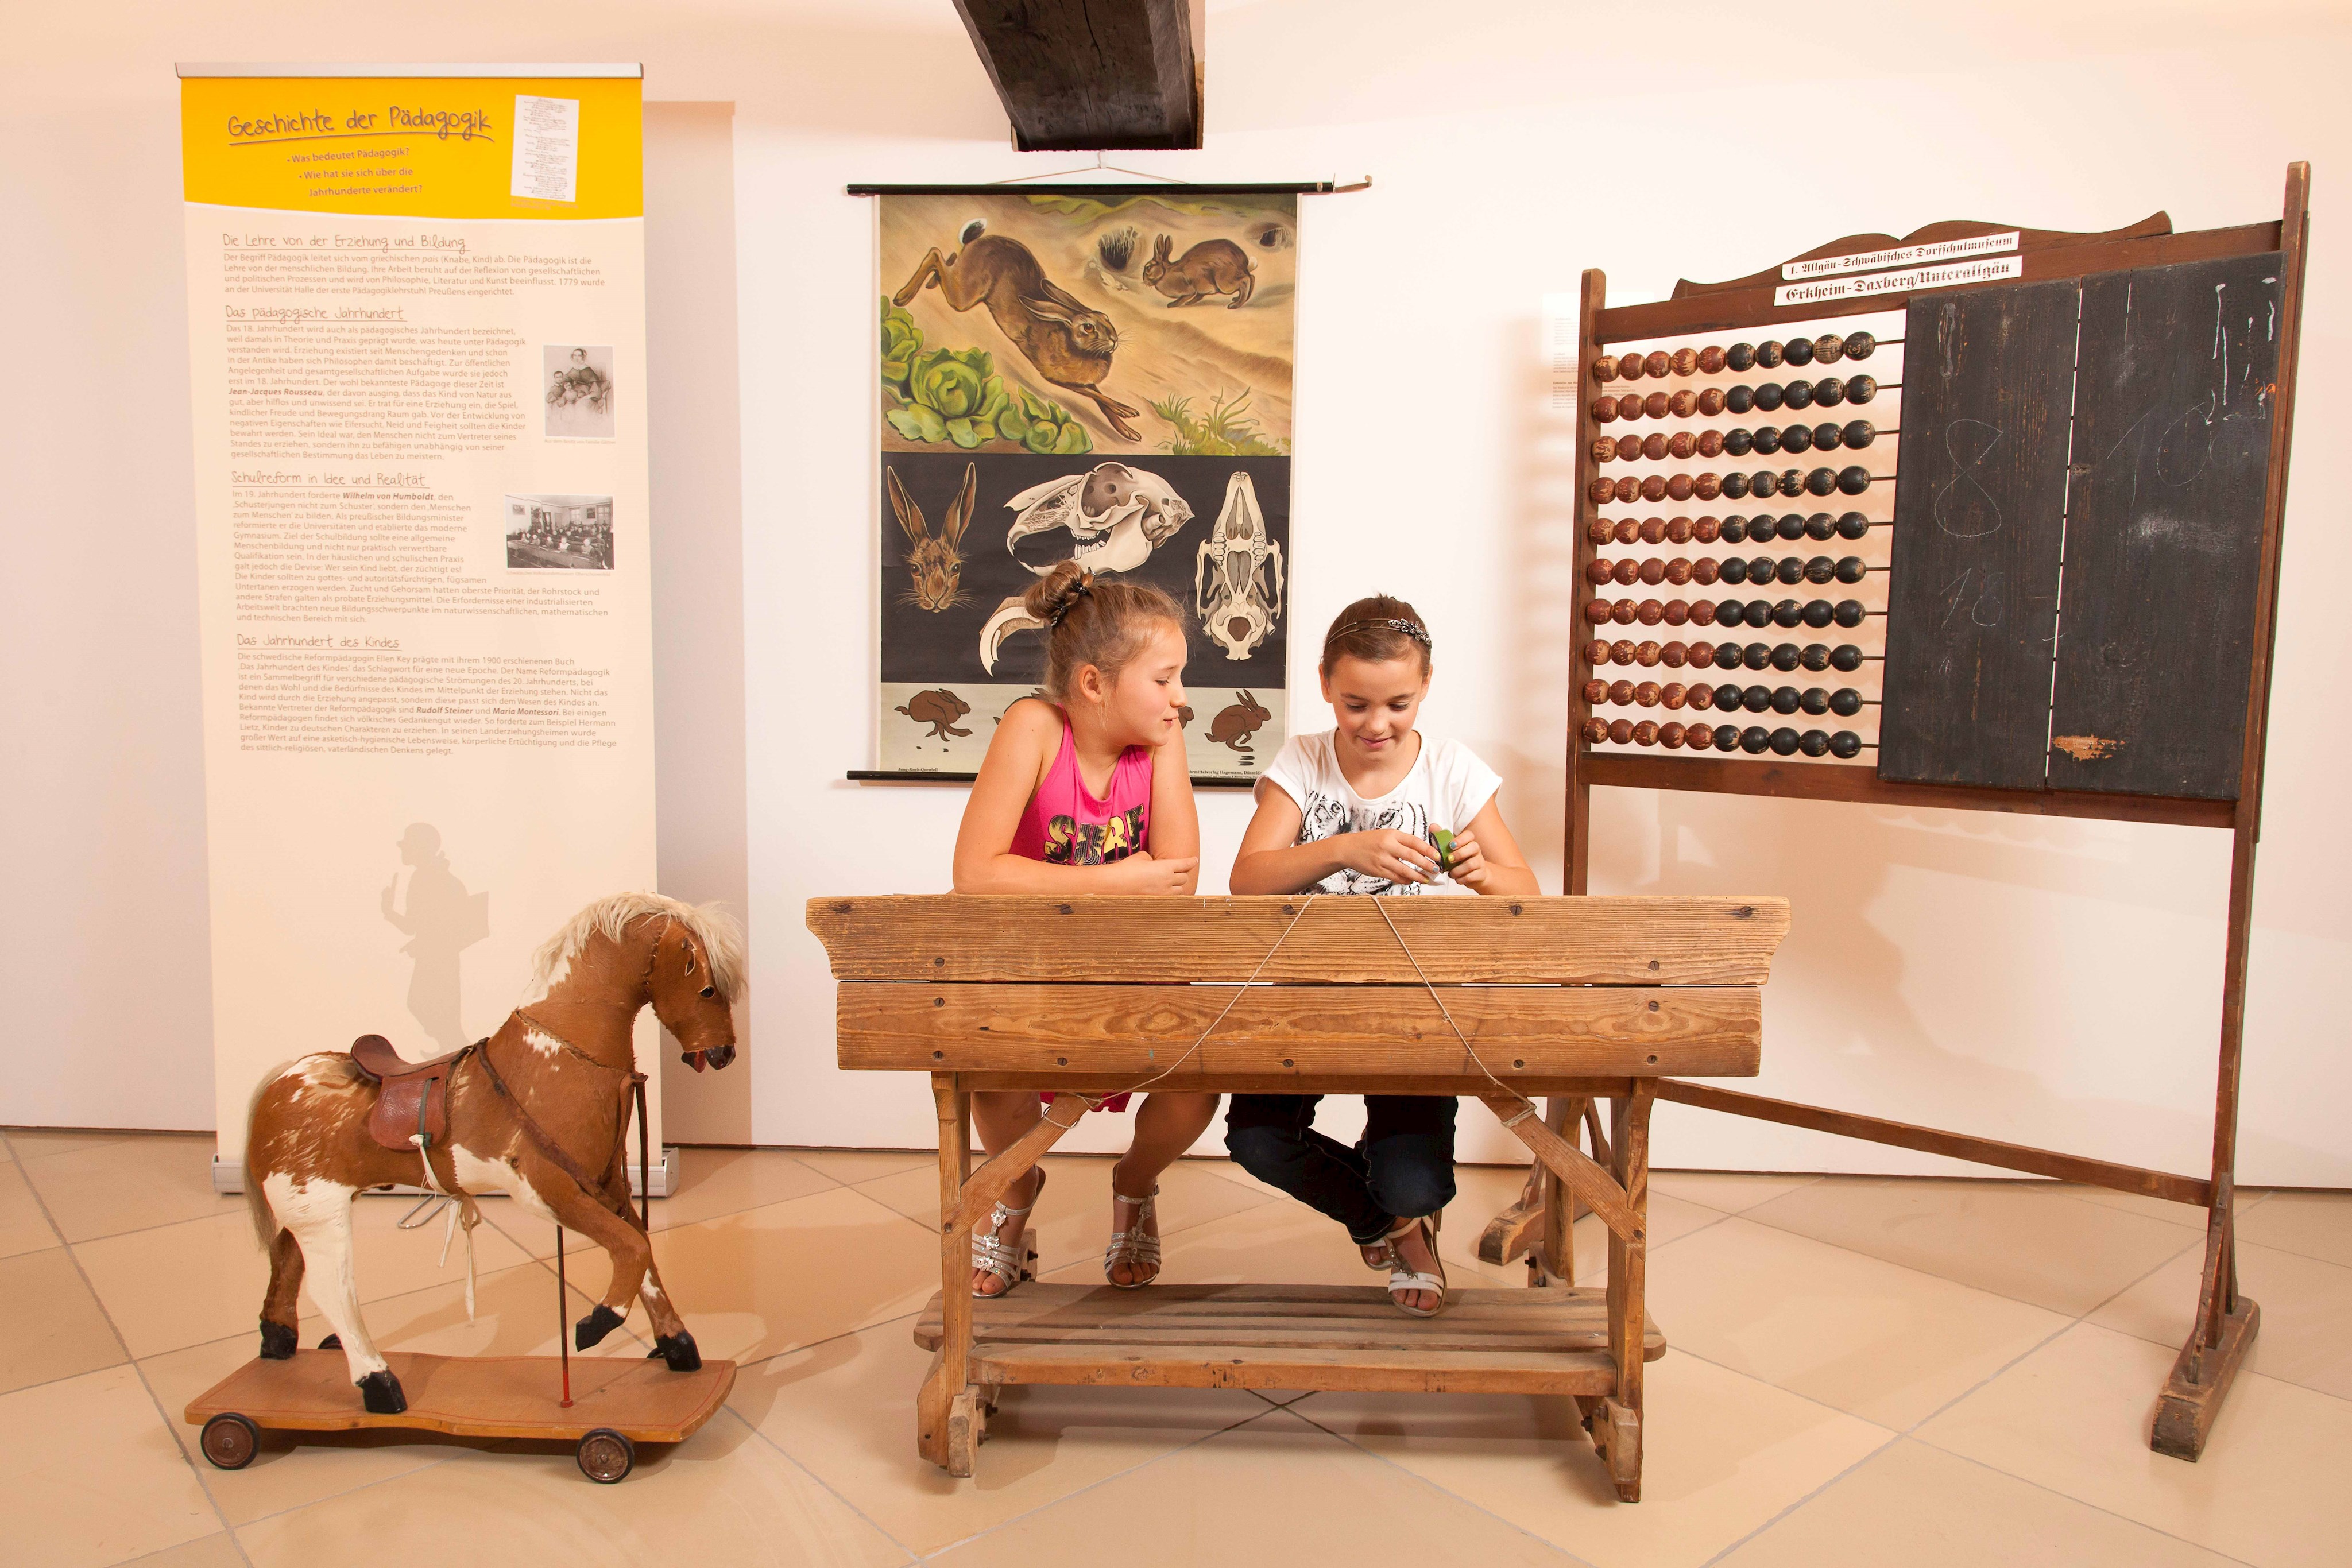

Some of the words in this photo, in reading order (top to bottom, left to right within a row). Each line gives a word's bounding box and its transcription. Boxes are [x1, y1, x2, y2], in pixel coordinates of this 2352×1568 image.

[228, 108, 334, 136] Geschichte
[346, 110, 377, 129] der
[389, 106, 492, 140] Pädagogik
[291, 154, 310, 163] Was
[312, 151, 354, 161] bedeutet
[357, 148, 409, 159] Pädagogik?
[304, 171, 321, 179] Wie
[323, 169, 338, 178] hat
[341, 169, 353, 177] sie
[356, 168, 373, 177] sich
[376, 167, 396, 176] über
[399, 167, 413, 175] die
[308, 186, 371, 197] Jahrhunderte
[373, 185, 422, 195] verändert?
[223, 234, 239, 247] Die
[245, 234, 277, 247] Lehre
[283, 237, 303, 246] von
[310, 236, 328, 247] der
[335, 235, 389, 253] Erziehung
[394, 235, 415, 247] und
[421, 234, 466, 254] Bildung
[223, 253, 238, 261] Der
[240, 253, 266, 263] Begriff
[267, 253, 309, 263] Pädagogik
[311, 254, 331, 262] leitet
[370, 254, 420, 264] griechischen
[422, 255, 438, 264] pais
[473, 255, 492, 264] Kind)
[524, 255, 566, 265] Pädagogik
[579, 257, 591, 266] die
[280, 264, 335, 273] menschlichen
[371, 265, 386, 273] Ihre
[388, 265, 413, 273] Arbeit
[414, 265, 442, 273] beruht
[444, 266, 458, 274] auf
[459, 266, 472, 274] der
[474, 266, 509, 274] Reflexion
[528, 266, 600, 276] gesellschaftlichen
[225, 274, 240, 282] und
[242, 274, 285, 284] politischen
[287, 275, 327, 285] Prozessen
[382, 276, 431, 285] Philosophie,
[433, 276, 467, 285] Literatur
[469, 277, 485, 285] und
[486, 276, 508, 284] Kunst
[510, 277, 556, 285] beeinflusst.
[252, 285, 292, 293] Universität
[295, 285, 314, 293] Halle
[316, 285, 329, 293] der
[352, 285, 426, 296] Pädagogiklehrstuhl
[428, 287, 466, 296] Preußens
[226, 305, 246, 318] Das
[252, 305, 328, 324] pädagogische
[335, 305, 404, 320] Jahrhundert
[226, 324, 241, 332] Das
[257, 324, 304, 332] Jahrhundert
[307, 325, 324, 334] wird
[326, 326, 346, 334] auch
[361, 326, 419, 335] pädagogisches
[420, 326, 470, 335] Jahrhundert
[245, 335, 272, 343] damals
[283, 335, 314, 343] Theorie
[358, 337, 389, 346] geprägt
[438, 337, 462, 346] heute
[486, 338, 526, 347] Pädagogik
[229, 388, 281, 397] Jean-Jacques
[231, 470, 301, 484] Schulreform
[308, 474, 318, 484] in
[324, 473, 346, 485] Idee
[352, 474, 370, 485] und
[377, 473, 425, 486] Realität
[1935, 418, 2004, 539] 8
[308, 491, 340, 499] forderte
[343, 491, 375, 500] Wilhelm
[237, 634, 257, 645] Das
[262, 634, 333, 648] Jahrhundert
[339, 636, 359, 648] des
[365, 636, 400, 648] Kindes
[330, 704, 396, 714] Reformpädagogik
[577, 709, 606, 718] einigen
[1043, 803, 1145, 866] SURF
